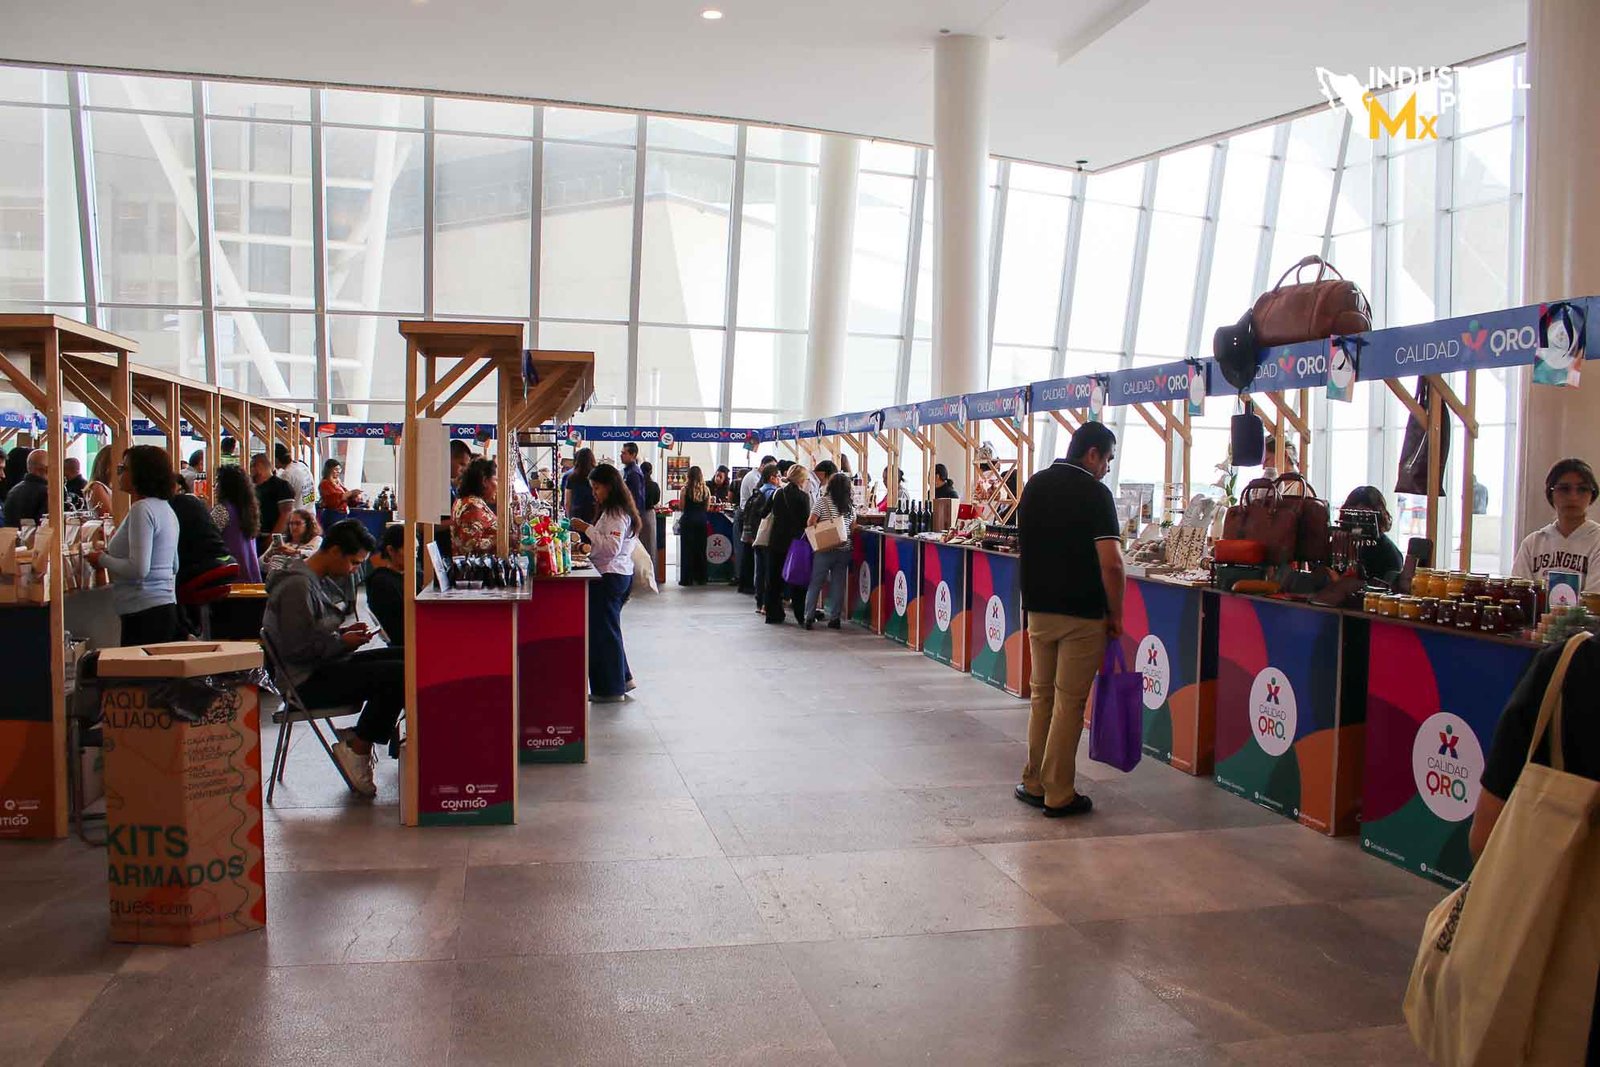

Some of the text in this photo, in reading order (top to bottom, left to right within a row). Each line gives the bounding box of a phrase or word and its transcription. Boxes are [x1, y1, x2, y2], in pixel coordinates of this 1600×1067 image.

[1395, 339, 1460, 365] CALIDAD
[1042, 387, 1066, 400] CALIDAD
[1123, 380, 1155, 395] CALIDAD
[1259, 704, 1287, 721] CALIDAD
[527, 737, 565, 748] CONTIGO
[1427, 757, 1469, 779] CALIDAD
[441, 797, 488, 810] CONTIGO
[106, 825, 189, 858] KITS
[109, 855, 245, 887] ARMADOS
